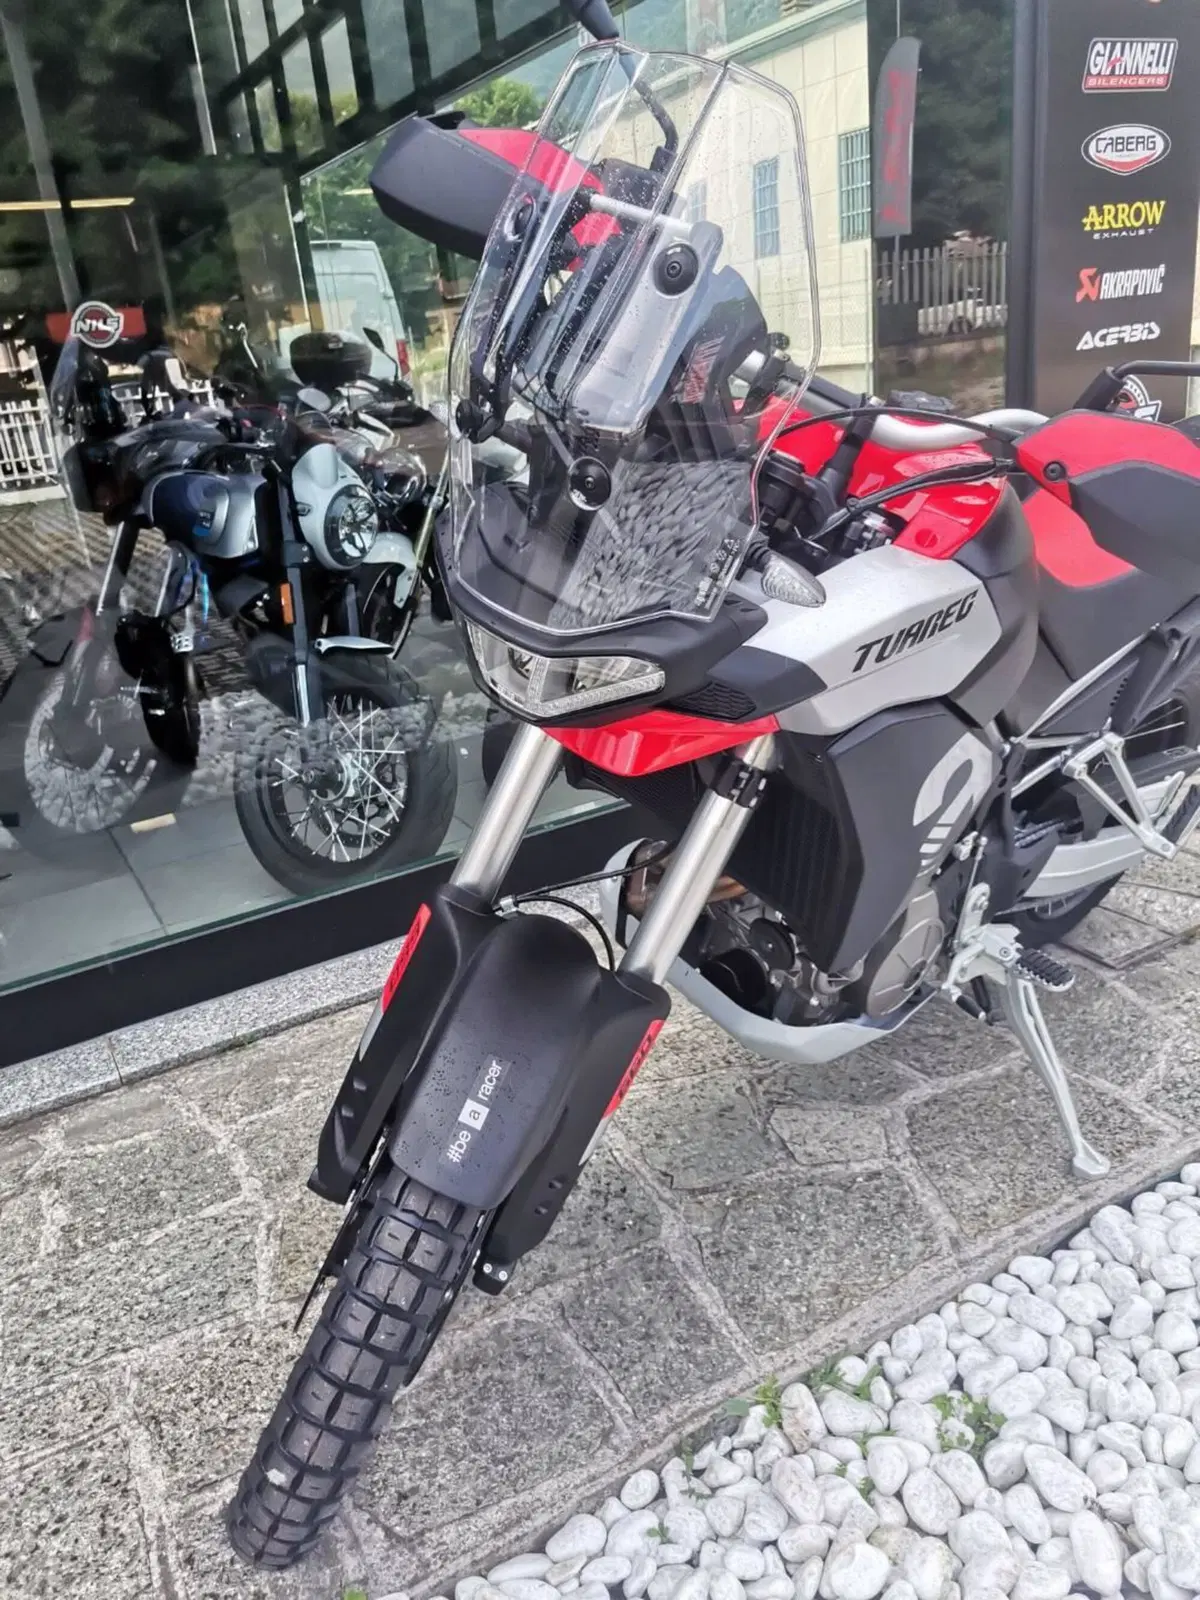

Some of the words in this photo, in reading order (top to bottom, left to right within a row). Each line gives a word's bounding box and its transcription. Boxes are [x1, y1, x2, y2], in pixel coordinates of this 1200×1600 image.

[1089, 41, 1174, 75] GIANNELLI
[1088, 77, 1165, 86] SILENCERS
[1095, 135, 1156, 153] CABERG
[1081, 201, 1166, 231] ARROW
[1093, 228, 1154, 240] EXHAUST
[1075, 321, 1161, 350] ACERBIS
[852, 589, 979, 673] TUAREG
[446, 1130, 472, 1162] #be
[477, 1060, 502, 1101] racer
